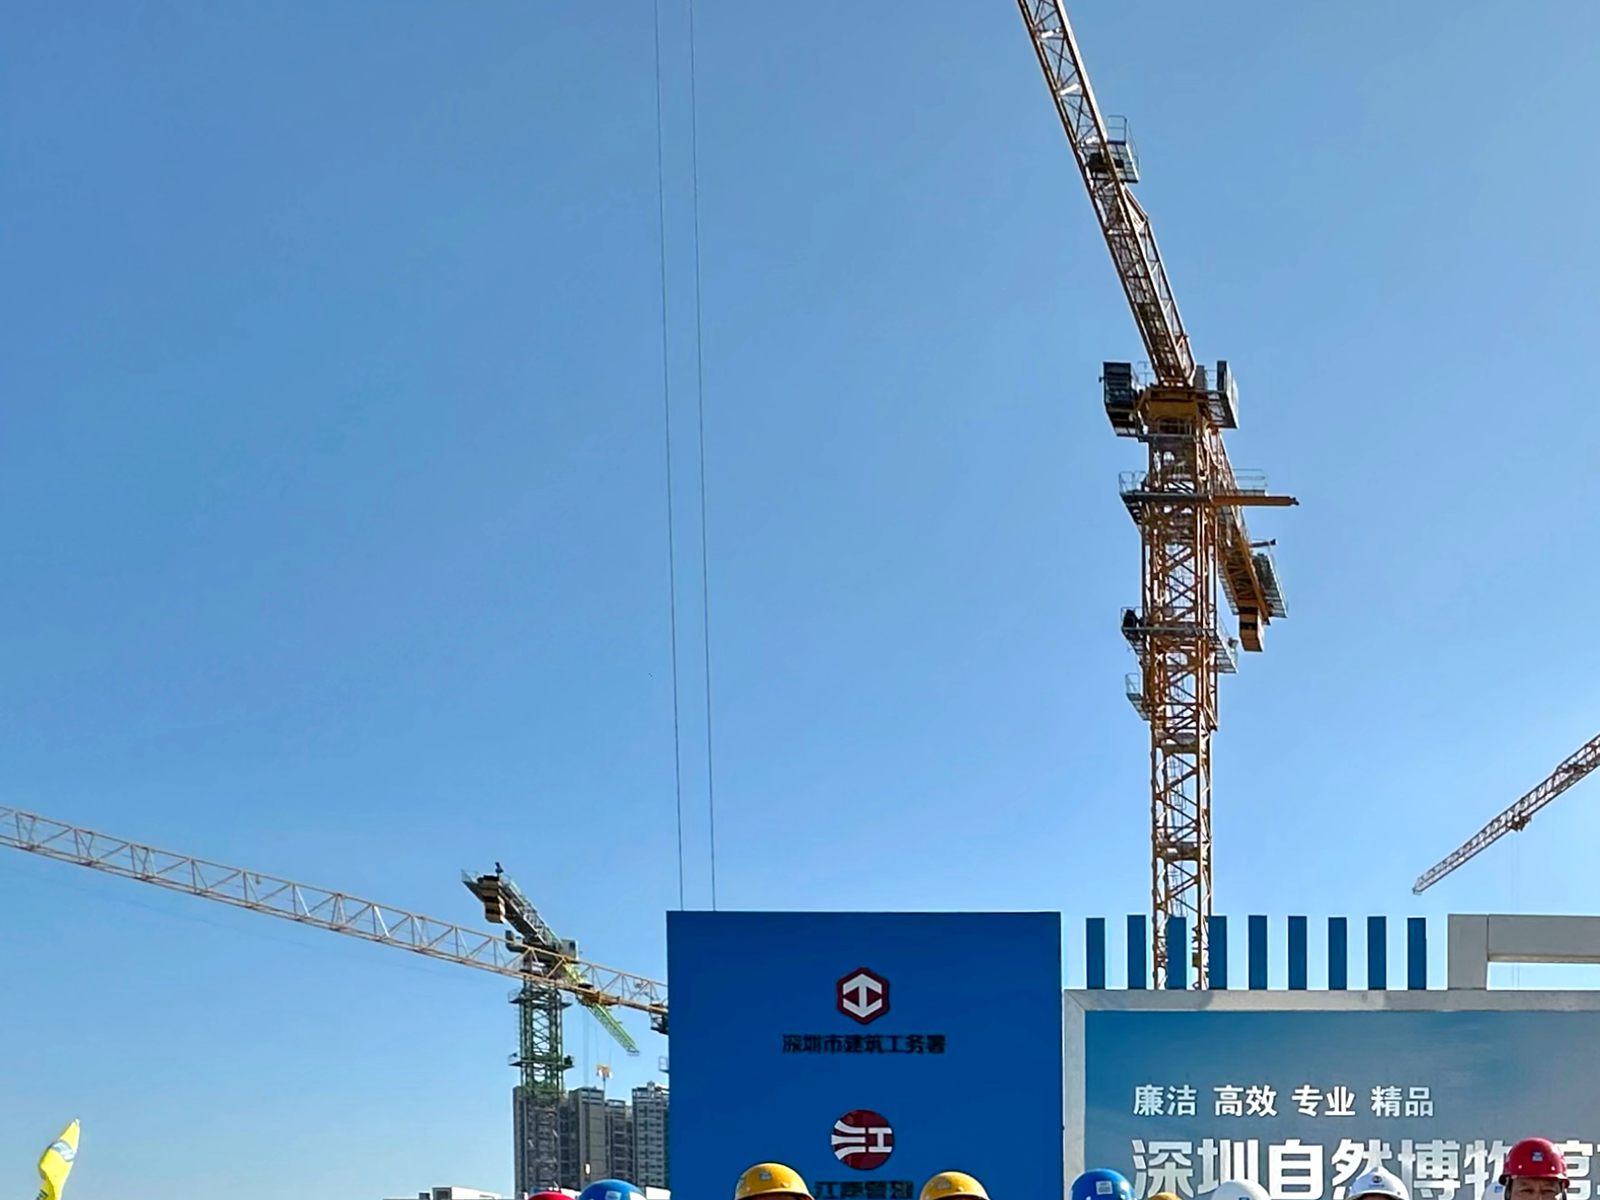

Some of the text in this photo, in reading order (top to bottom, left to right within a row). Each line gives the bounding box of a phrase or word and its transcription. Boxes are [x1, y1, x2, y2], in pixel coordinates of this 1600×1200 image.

[782, 1034, 945, 1054] 深圳市建筑工务署
[1133, 1085, 1434, 1117] 廉洁 高效 专业 精品
